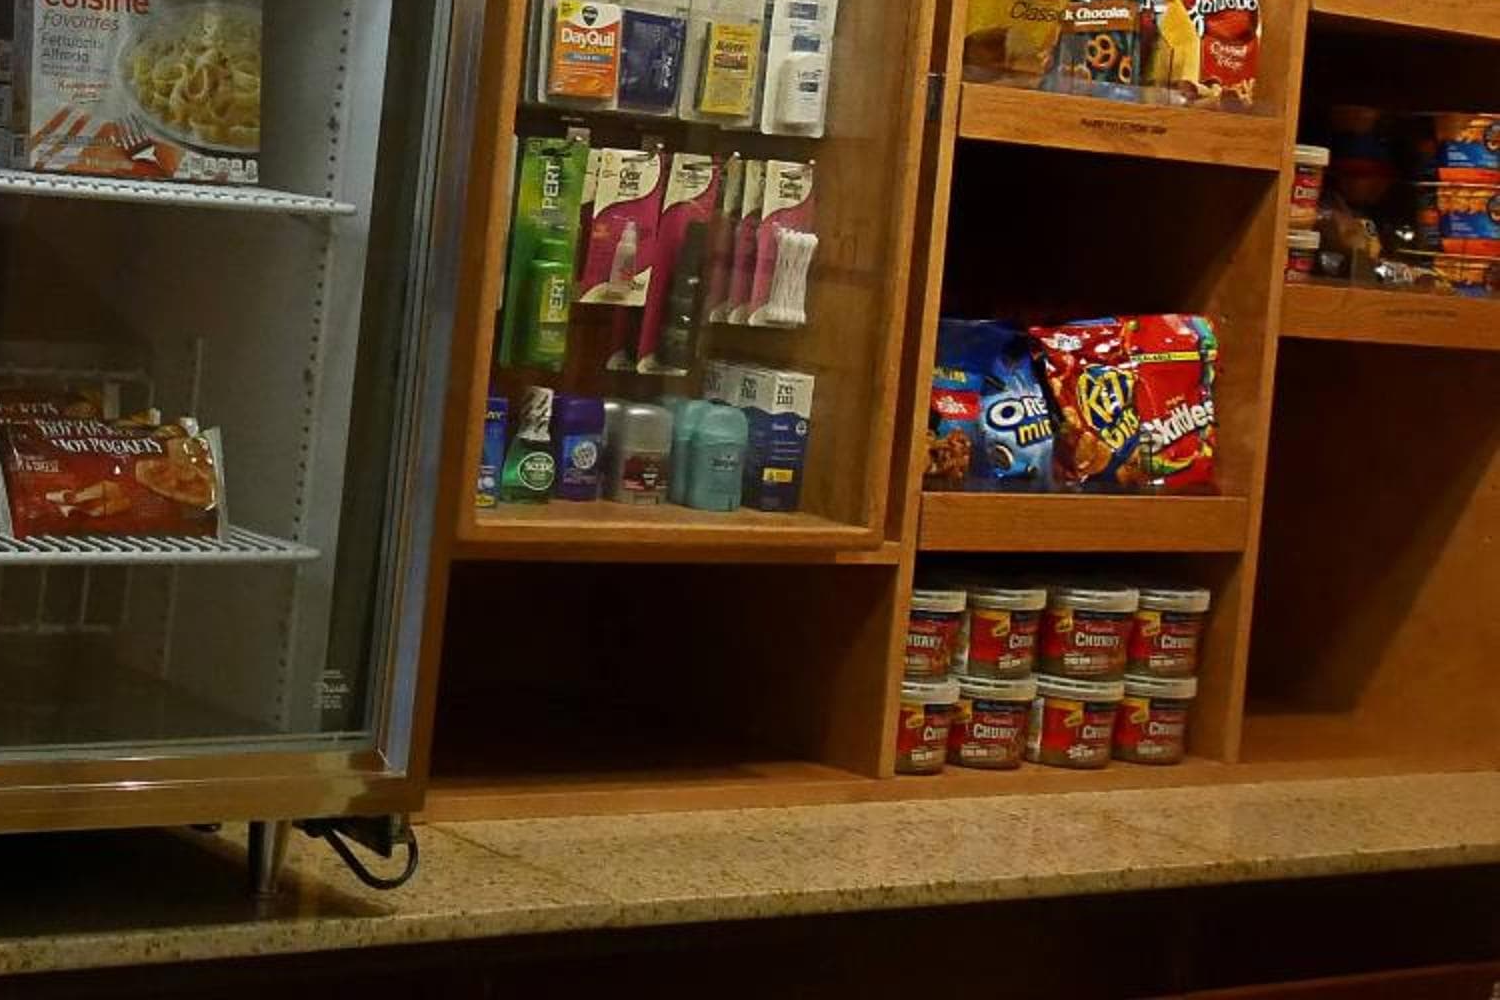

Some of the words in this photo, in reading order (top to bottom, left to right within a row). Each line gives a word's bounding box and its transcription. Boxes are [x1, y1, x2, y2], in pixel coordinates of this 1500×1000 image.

[560, 27, 615, 52] DayQuil
[542, 160, 562, 209] PERT
[989, 397, 1049, 427] ORE
[1139, 400, 1214, 453] Skittles
